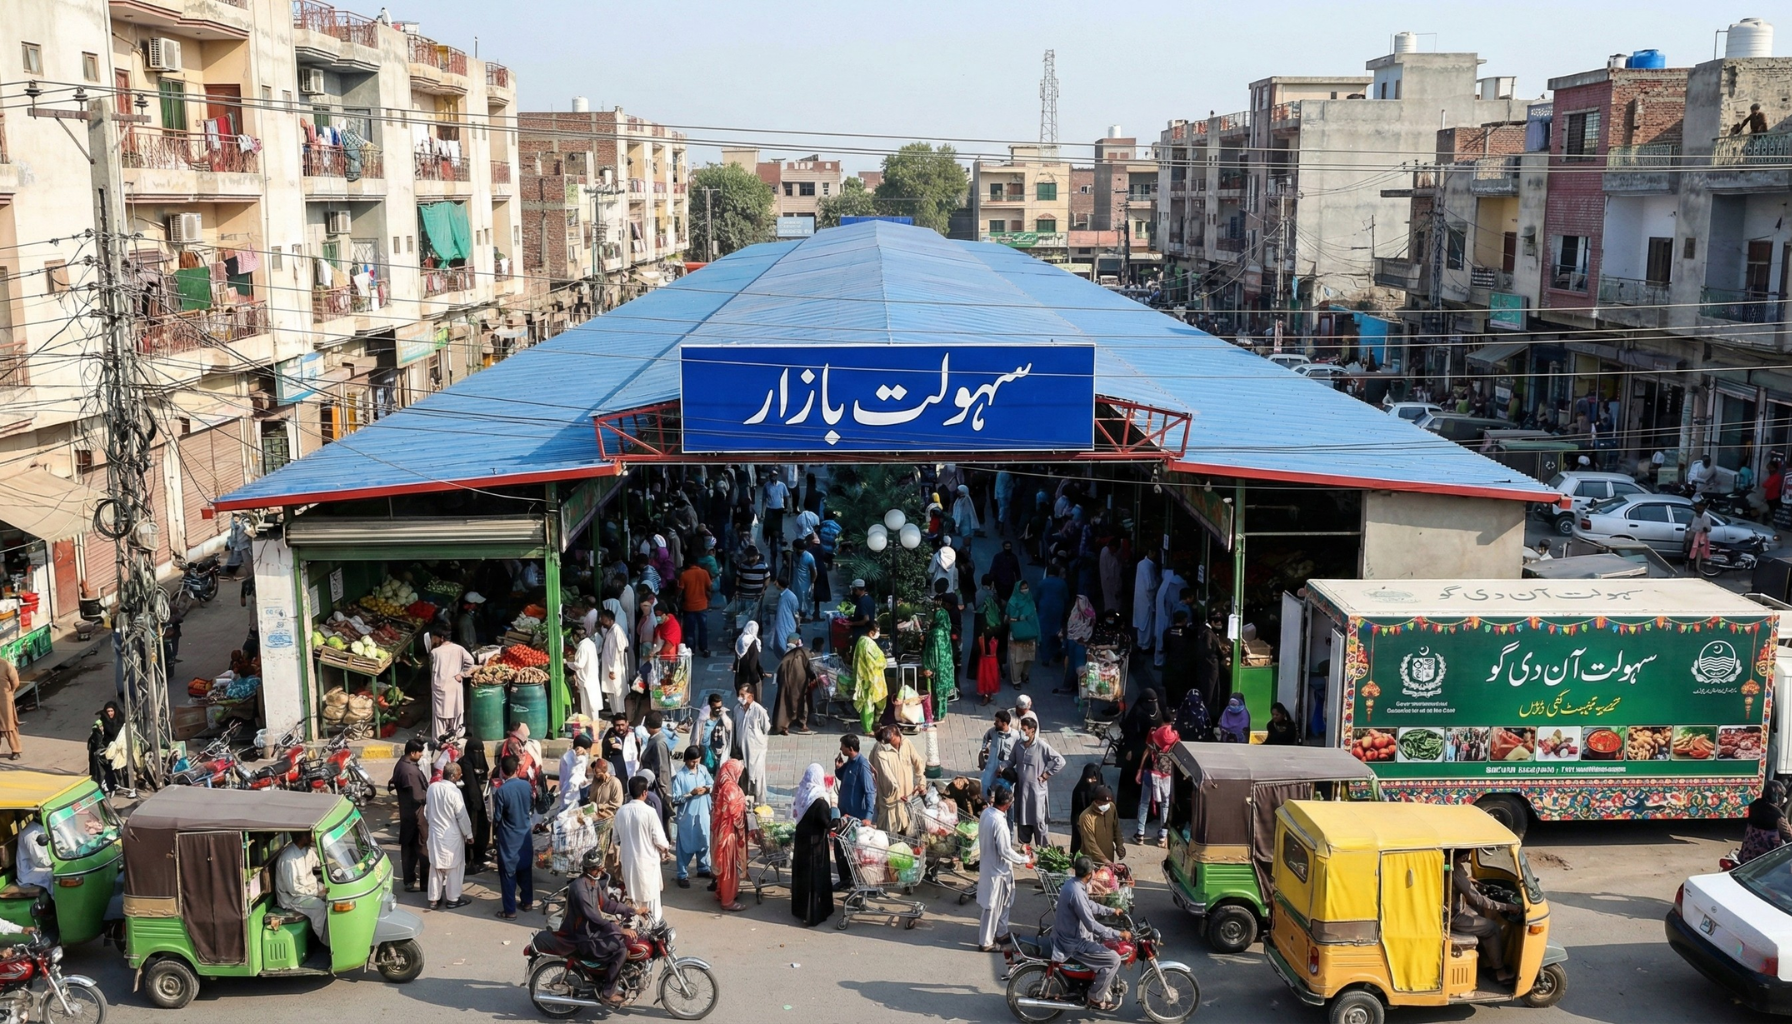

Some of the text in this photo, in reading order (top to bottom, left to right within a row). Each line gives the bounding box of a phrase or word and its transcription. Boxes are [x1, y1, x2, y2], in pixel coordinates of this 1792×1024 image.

[742, 352, 1032, 446] سہولت بازار
[1485, 640, 1658, 687] سہولت آن دی گو
